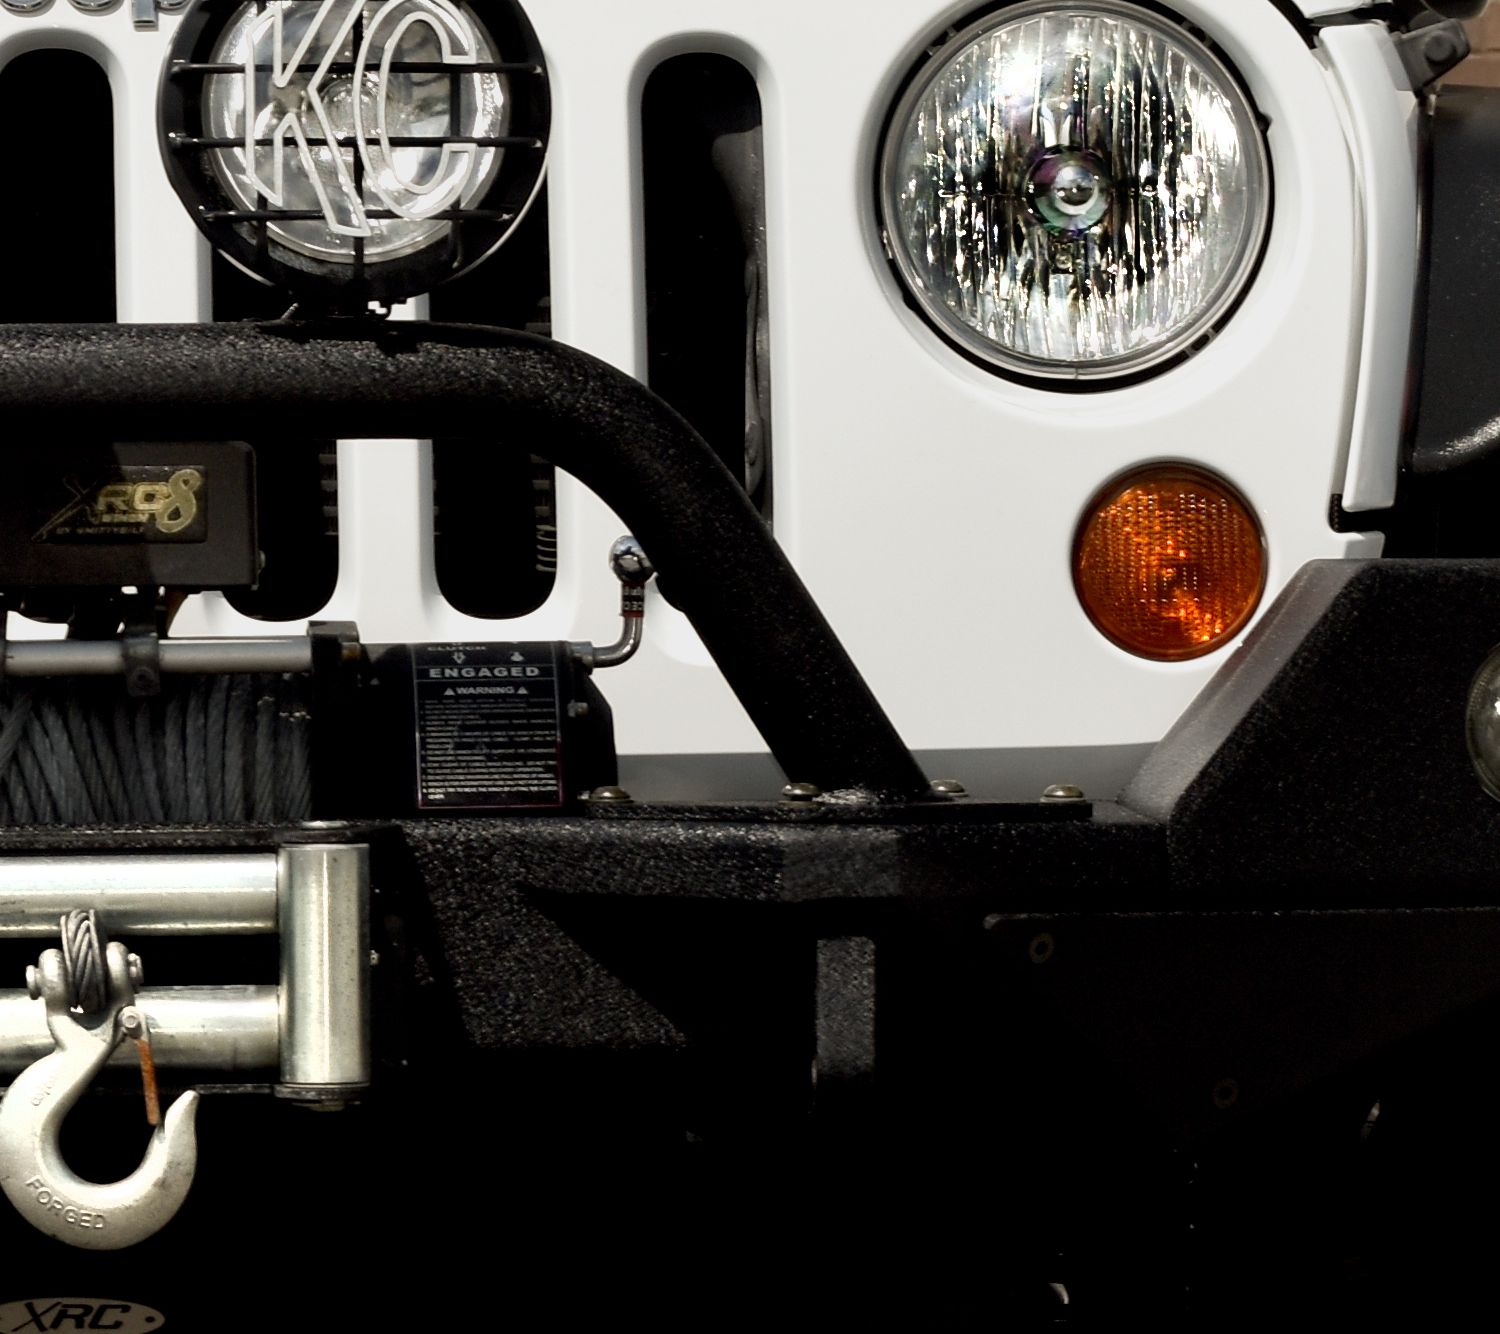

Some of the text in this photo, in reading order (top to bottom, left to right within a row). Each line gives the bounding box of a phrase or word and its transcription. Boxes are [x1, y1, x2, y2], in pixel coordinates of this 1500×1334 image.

[428, 666, 540, 679] ENGAGED
[455, 686, 515, 695] WARNING
[25, 1174, 107, 1230] FORGED
[10, 1301, 132, 1334] XRC
